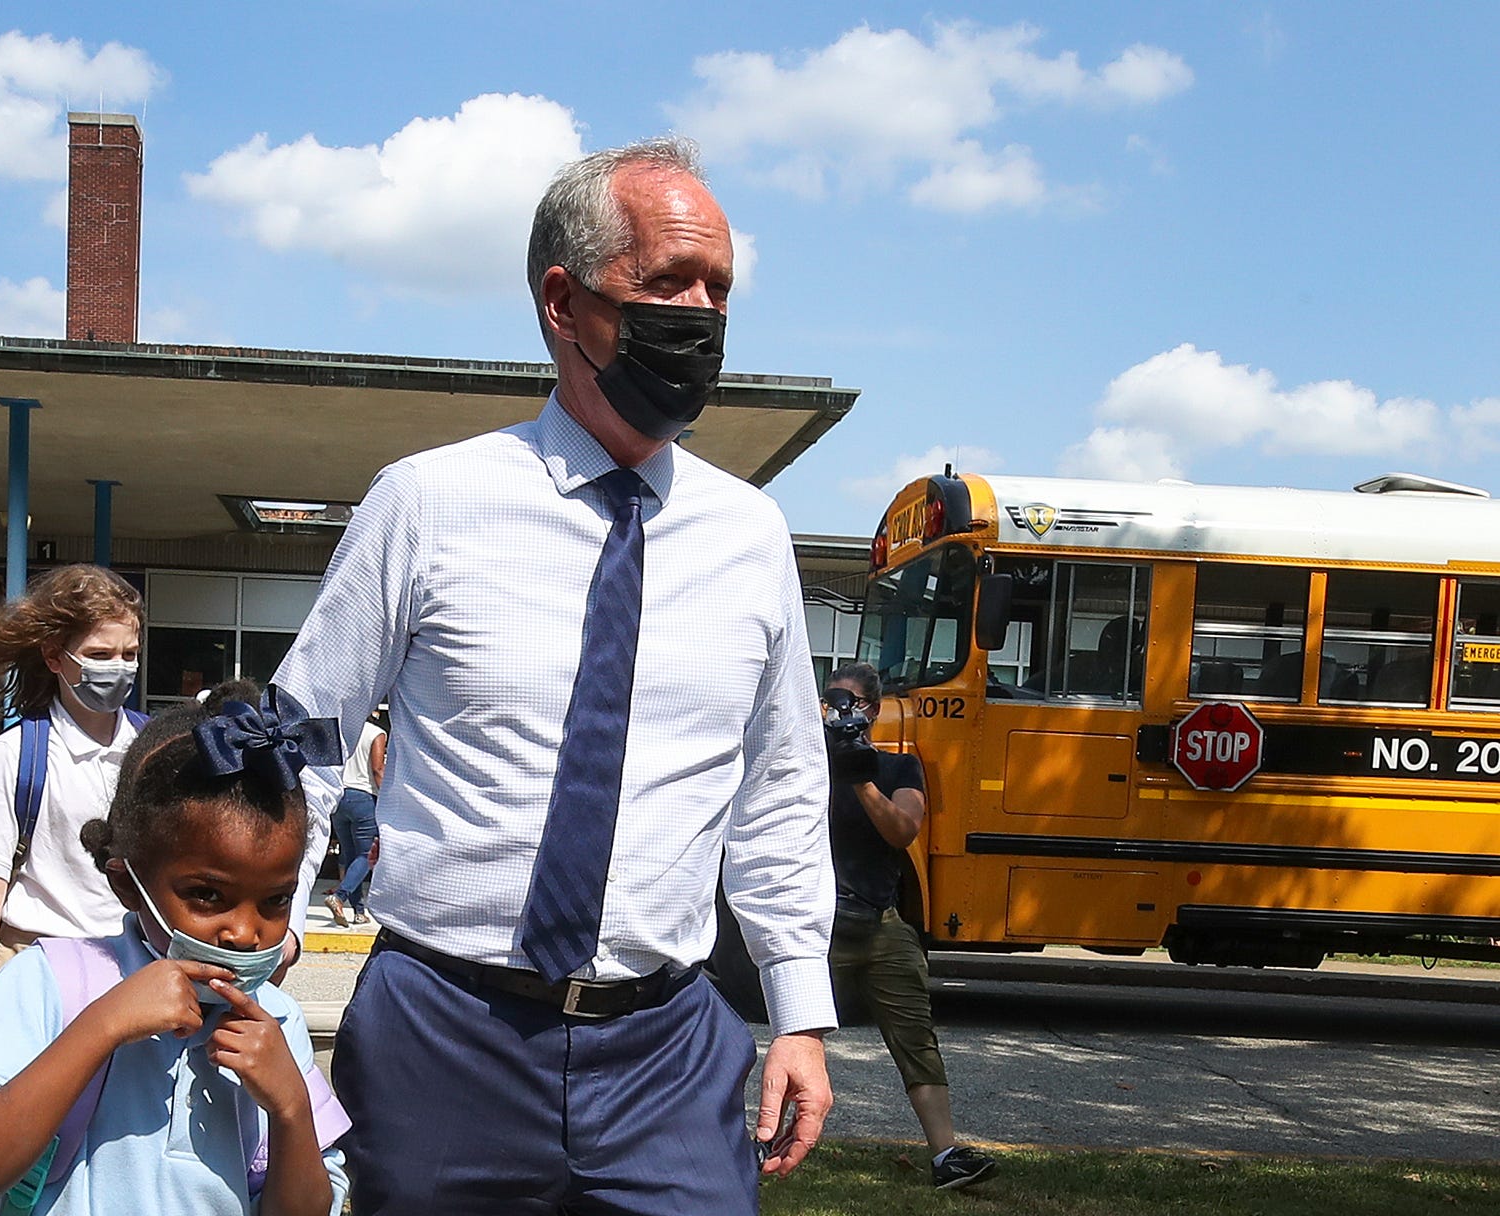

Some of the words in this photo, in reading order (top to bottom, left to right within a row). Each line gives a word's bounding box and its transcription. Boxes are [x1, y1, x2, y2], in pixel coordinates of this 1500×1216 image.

[42, 543, 50, 559] 1
[1186, 730, 1251, 763] STOP
[1372, 737, 1438, 772] NO.
